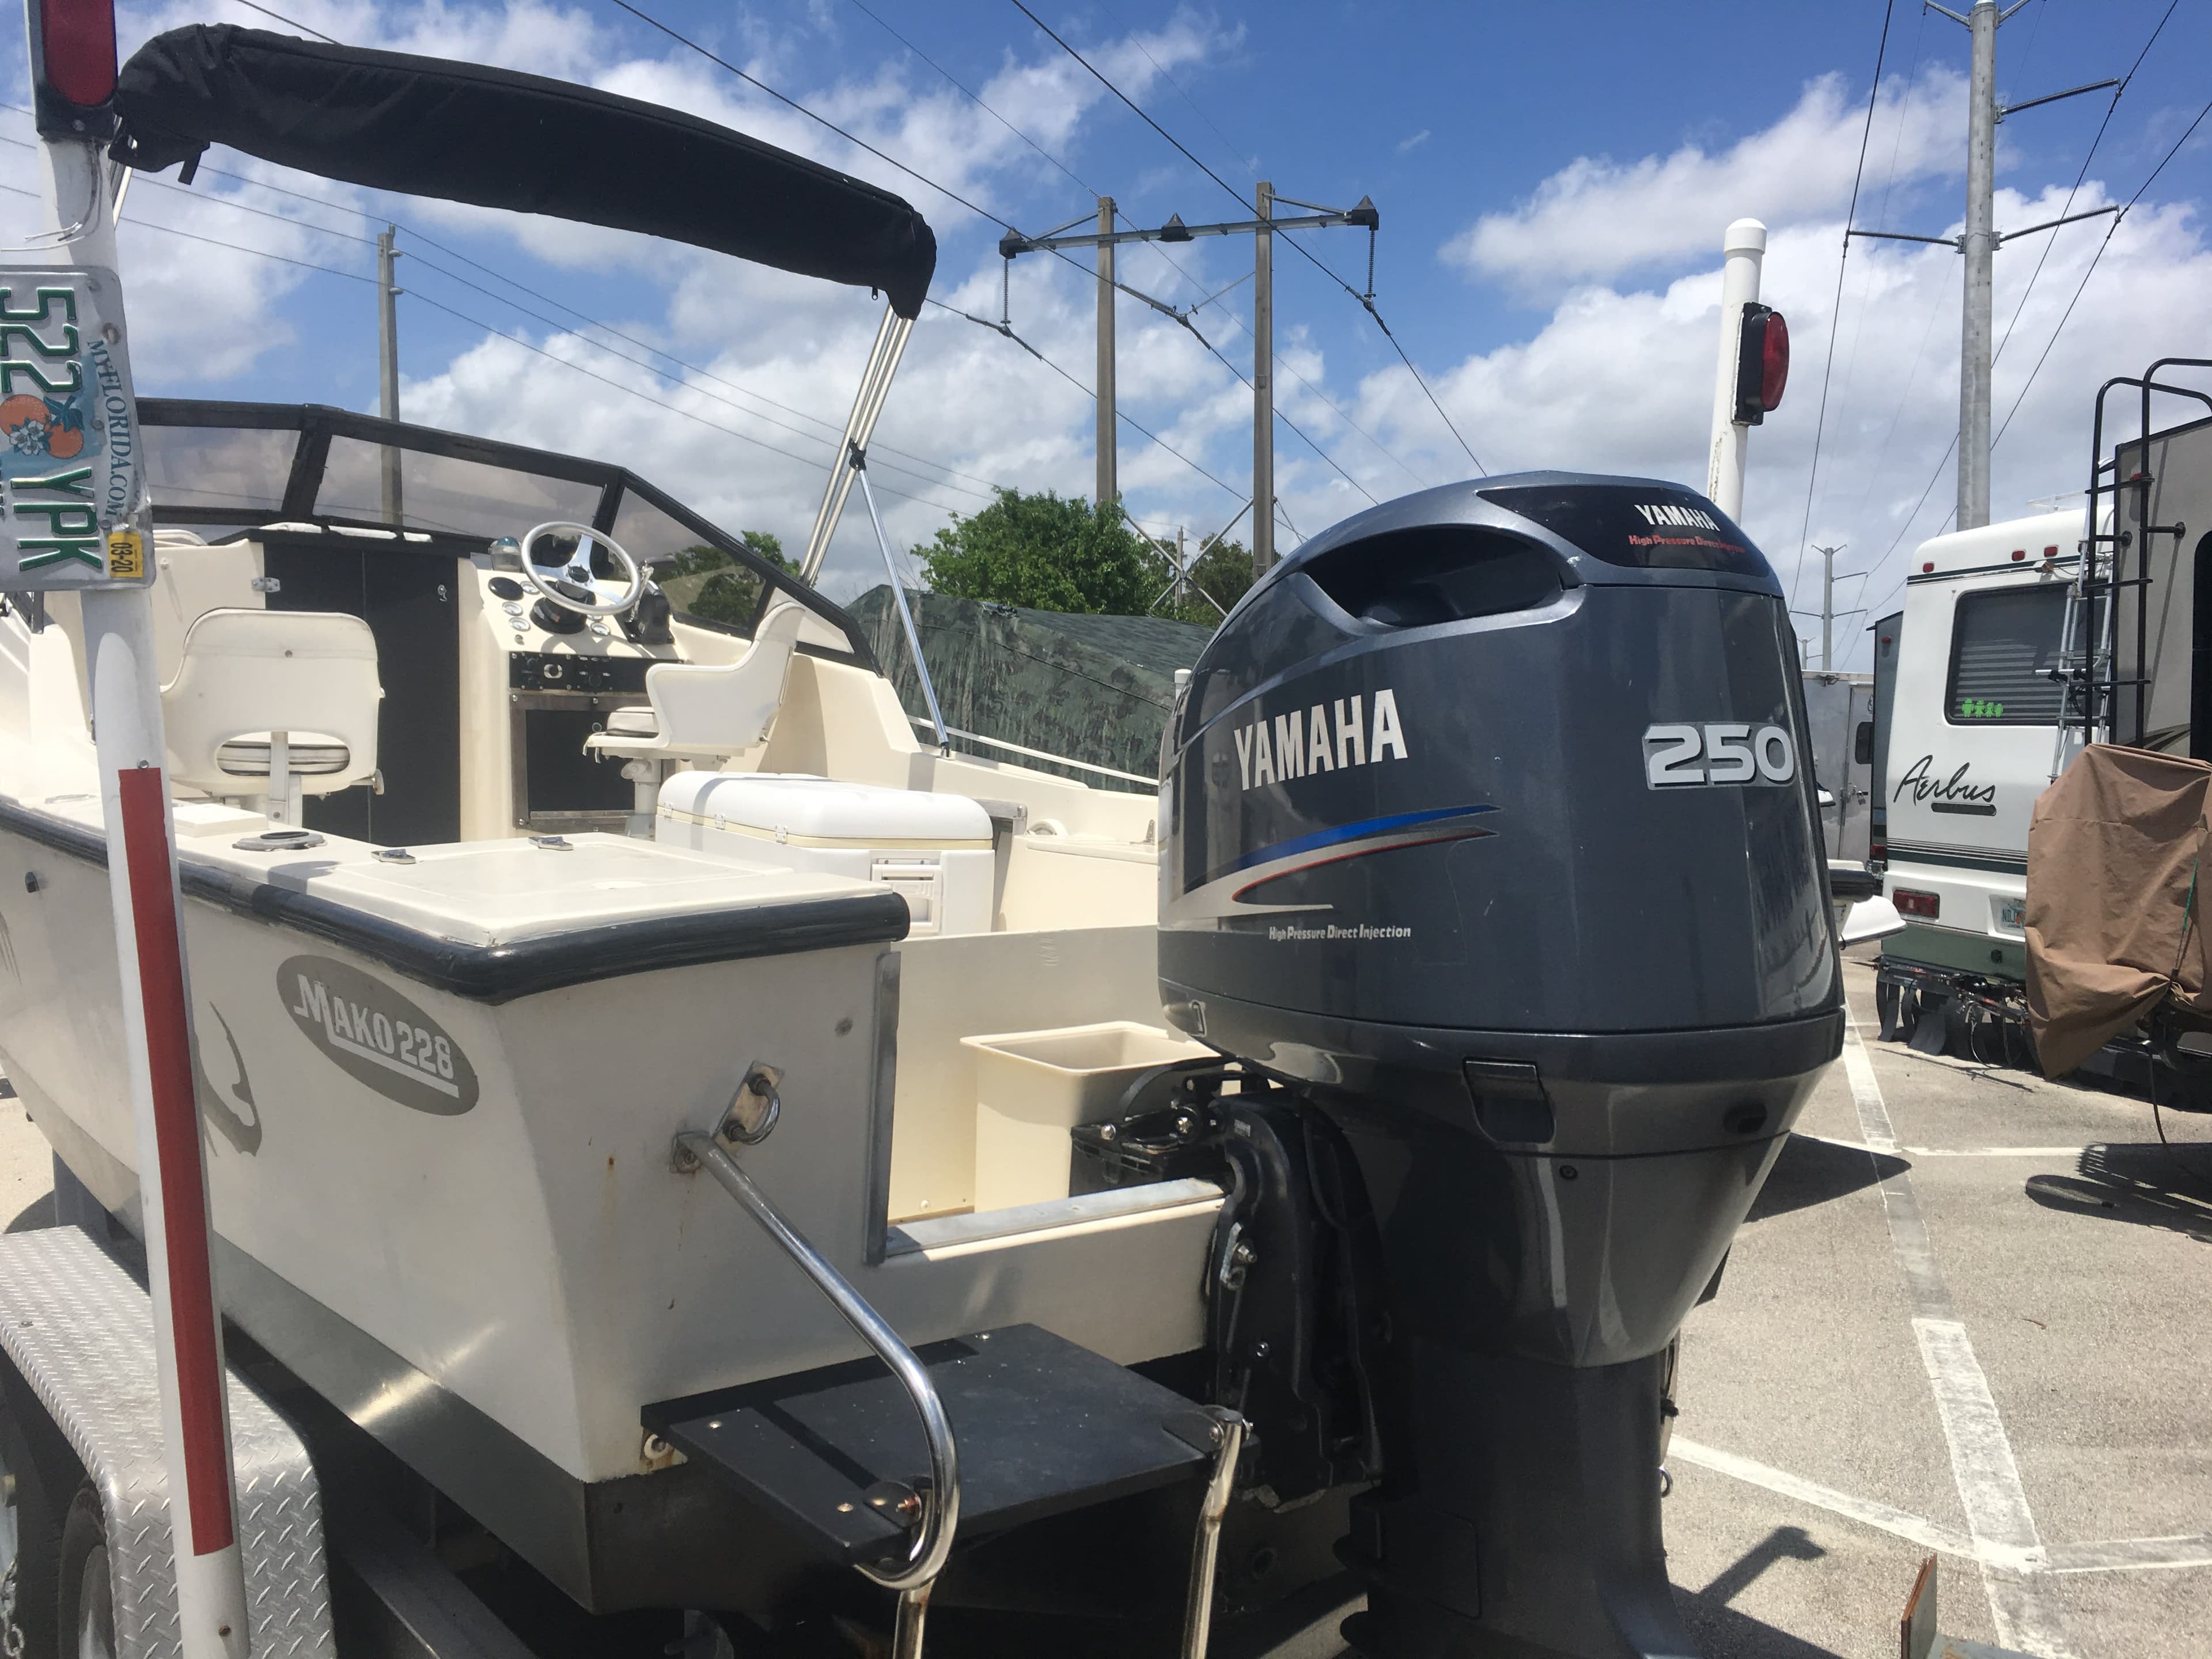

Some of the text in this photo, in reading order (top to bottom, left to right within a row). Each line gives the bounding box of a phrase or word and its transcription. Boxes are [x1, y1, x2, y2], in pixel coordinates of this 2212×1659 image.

[0, 288, 104, 572] 522 YPK
[87, 339, 132, 517] MYFLORIDA.COM
[1628, 535, 1652, 546] High
[1653, 535, 1695, 546] Pressure
[1634, 505, 1721, 532] YAMAHA
[110, 542, 133, 573] 03-20
[1233, 688, 1408, 791] YAMAHA
[1644, 724, 1794, 785] 250
[1269, 924, 1411, 941] High Pressure Direct Injection
[293, 974, 454, 1080] MAKO 228
